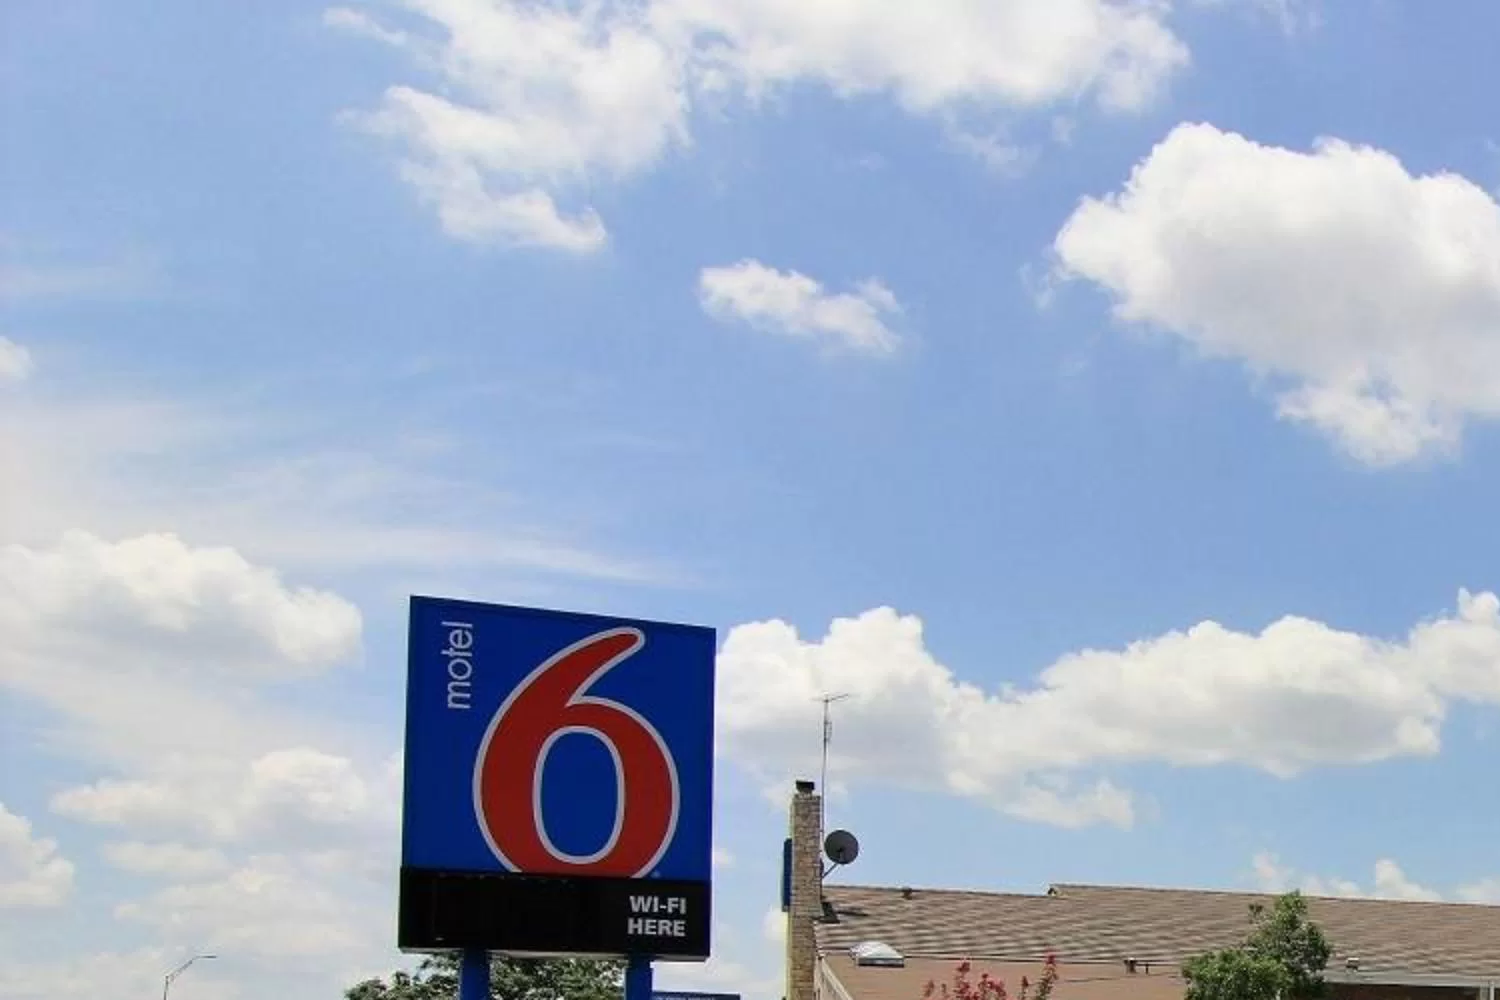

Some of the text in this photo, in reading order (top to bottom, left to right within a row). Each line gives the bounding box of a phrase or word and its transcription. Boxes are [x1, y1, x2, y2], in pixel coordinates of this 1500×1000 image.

[441, 621, 473, 709] motel
[472, 627, 680, 879] 6
[627, 917, 686, 937] HERE
[629, 895, 687, 915] WI-FI
